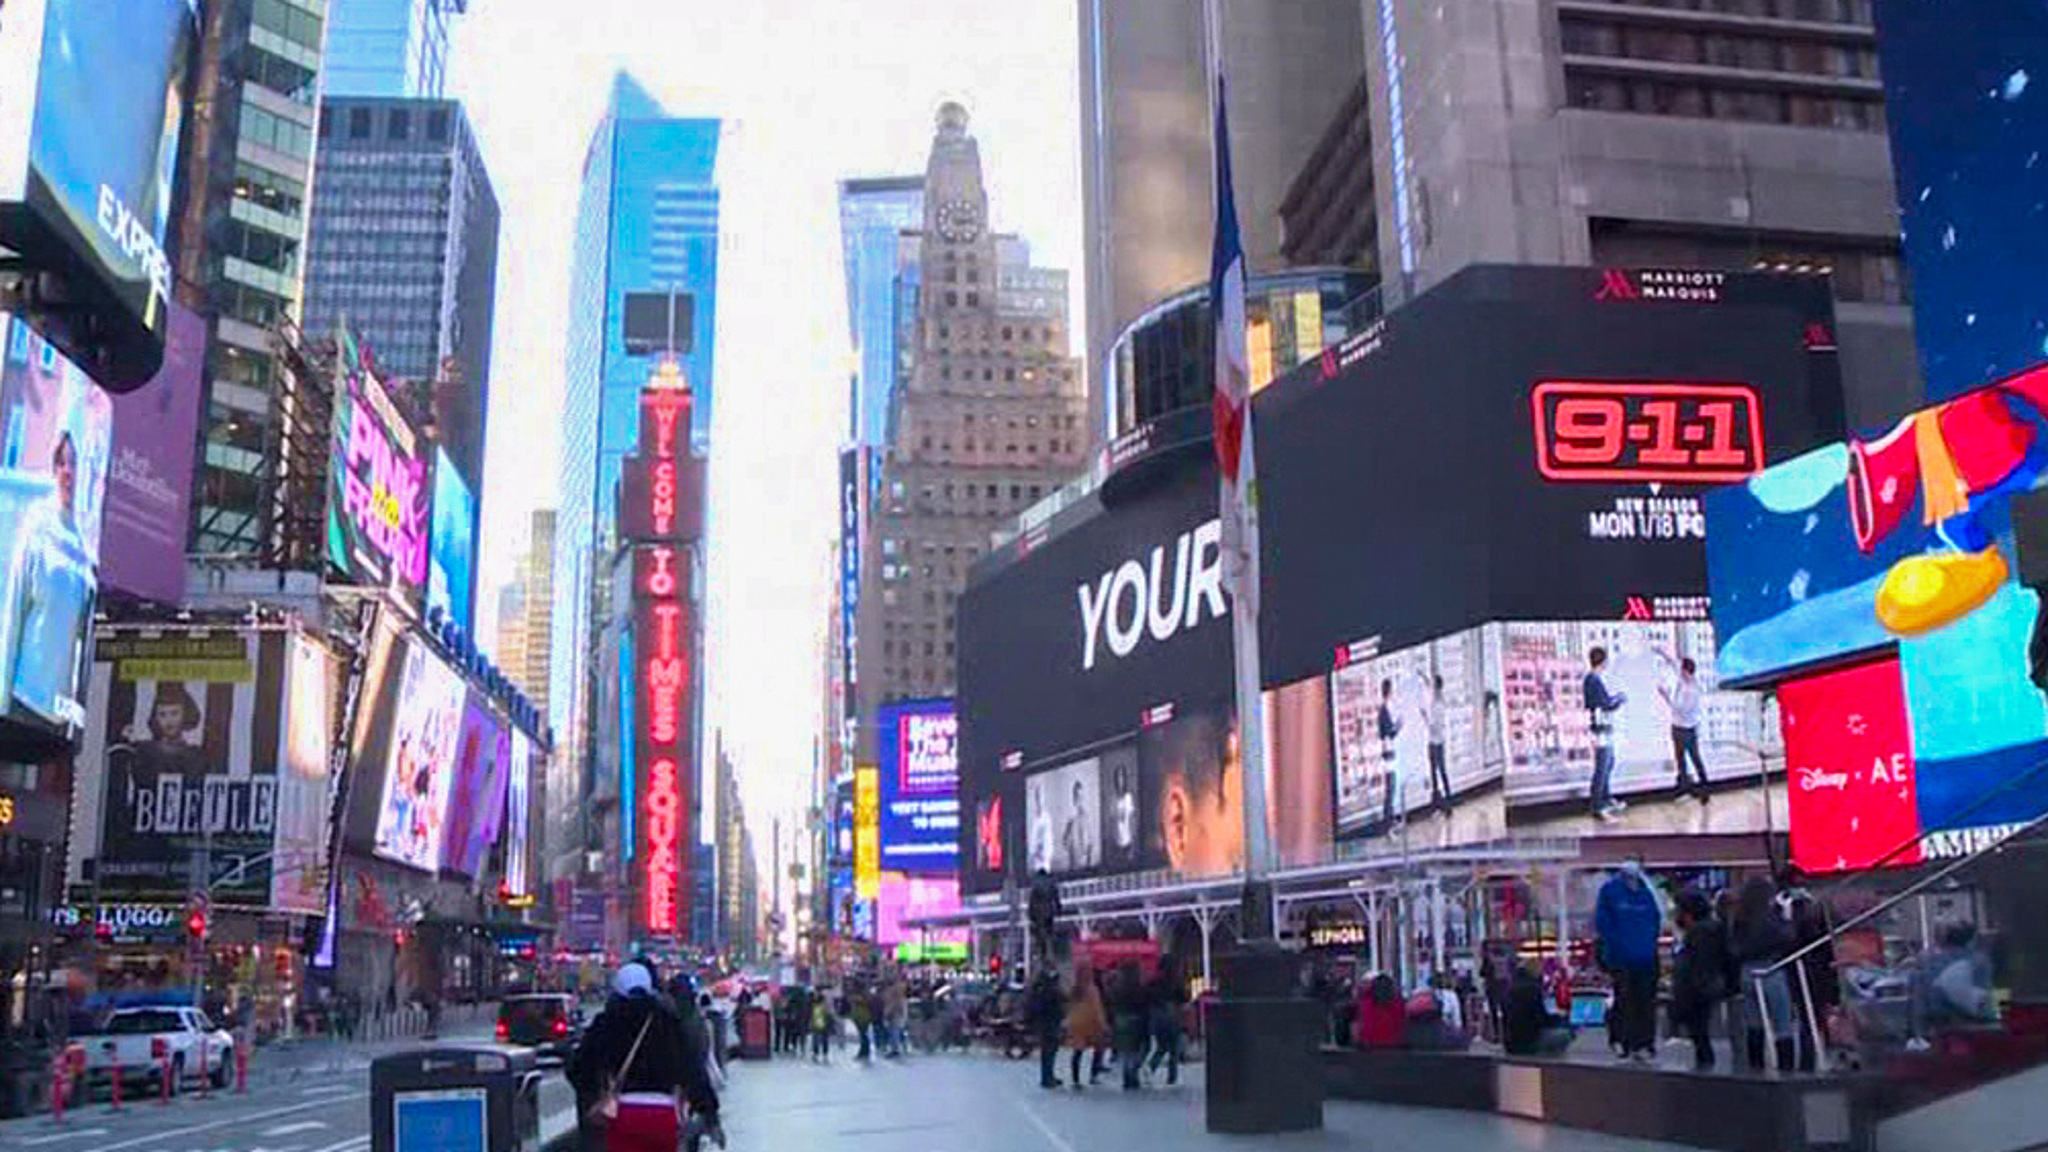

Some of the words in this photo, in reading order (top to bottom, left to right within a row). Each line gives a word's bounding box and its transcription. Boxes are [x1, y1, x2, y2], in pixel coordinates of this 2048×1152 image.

[1641, 272, 1724, 285] MARRIOTT
[1642, 286, 1717, 300] MARQUIS
[653, 407, 677, 534] WELCOME
[1589, 512, 1635, 537] MON
[1638, 512, 1674, 538] 1/18
[1615, 498, 1645, 512] NEW
[1648, 498, 1698, 512] SEASON
[650, 549, 674, 595] TO
[1077, 519, 1227, 671] YOUR
[650, 605, 681, 742] TIMES
[1796, 767, 1848, 791] Disney
[1870, 753, 1908, 785] AE
[135, 773, 275, 833] BEETLE
[648, 758, 678, 929] SQUARE
[1310, 926, 1365, 946] SEPHORA
